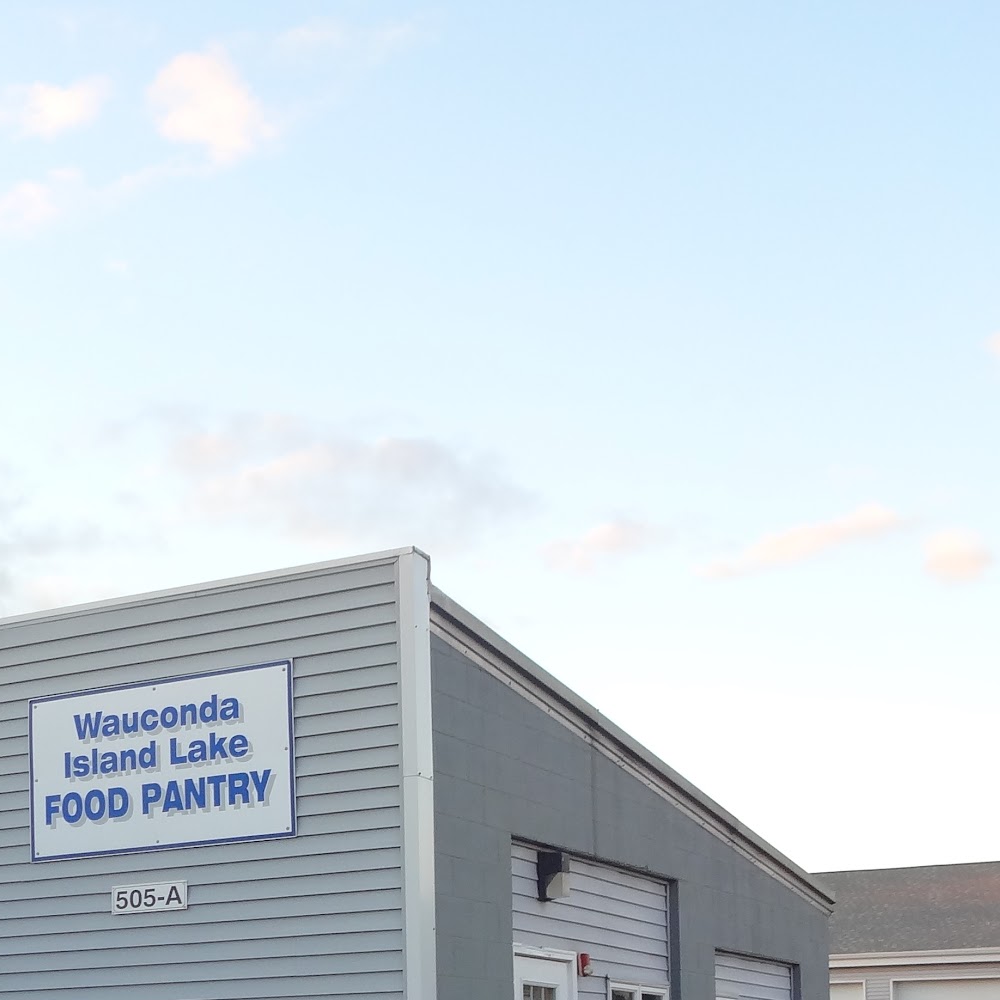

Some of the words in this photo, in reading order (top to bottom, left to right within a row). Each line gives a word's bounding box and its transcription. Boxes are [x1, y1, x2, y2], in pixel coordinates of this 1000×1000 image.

[73, 694, 240, 740] Wauconda
[64, 741, 157, 778] Island
[169, 732, 249, 765] Lake
[45, 787, 129, 825] FOOD
[141, 769, 272, 815] PANTRY
[115, 885, 182, 910] 505-A
